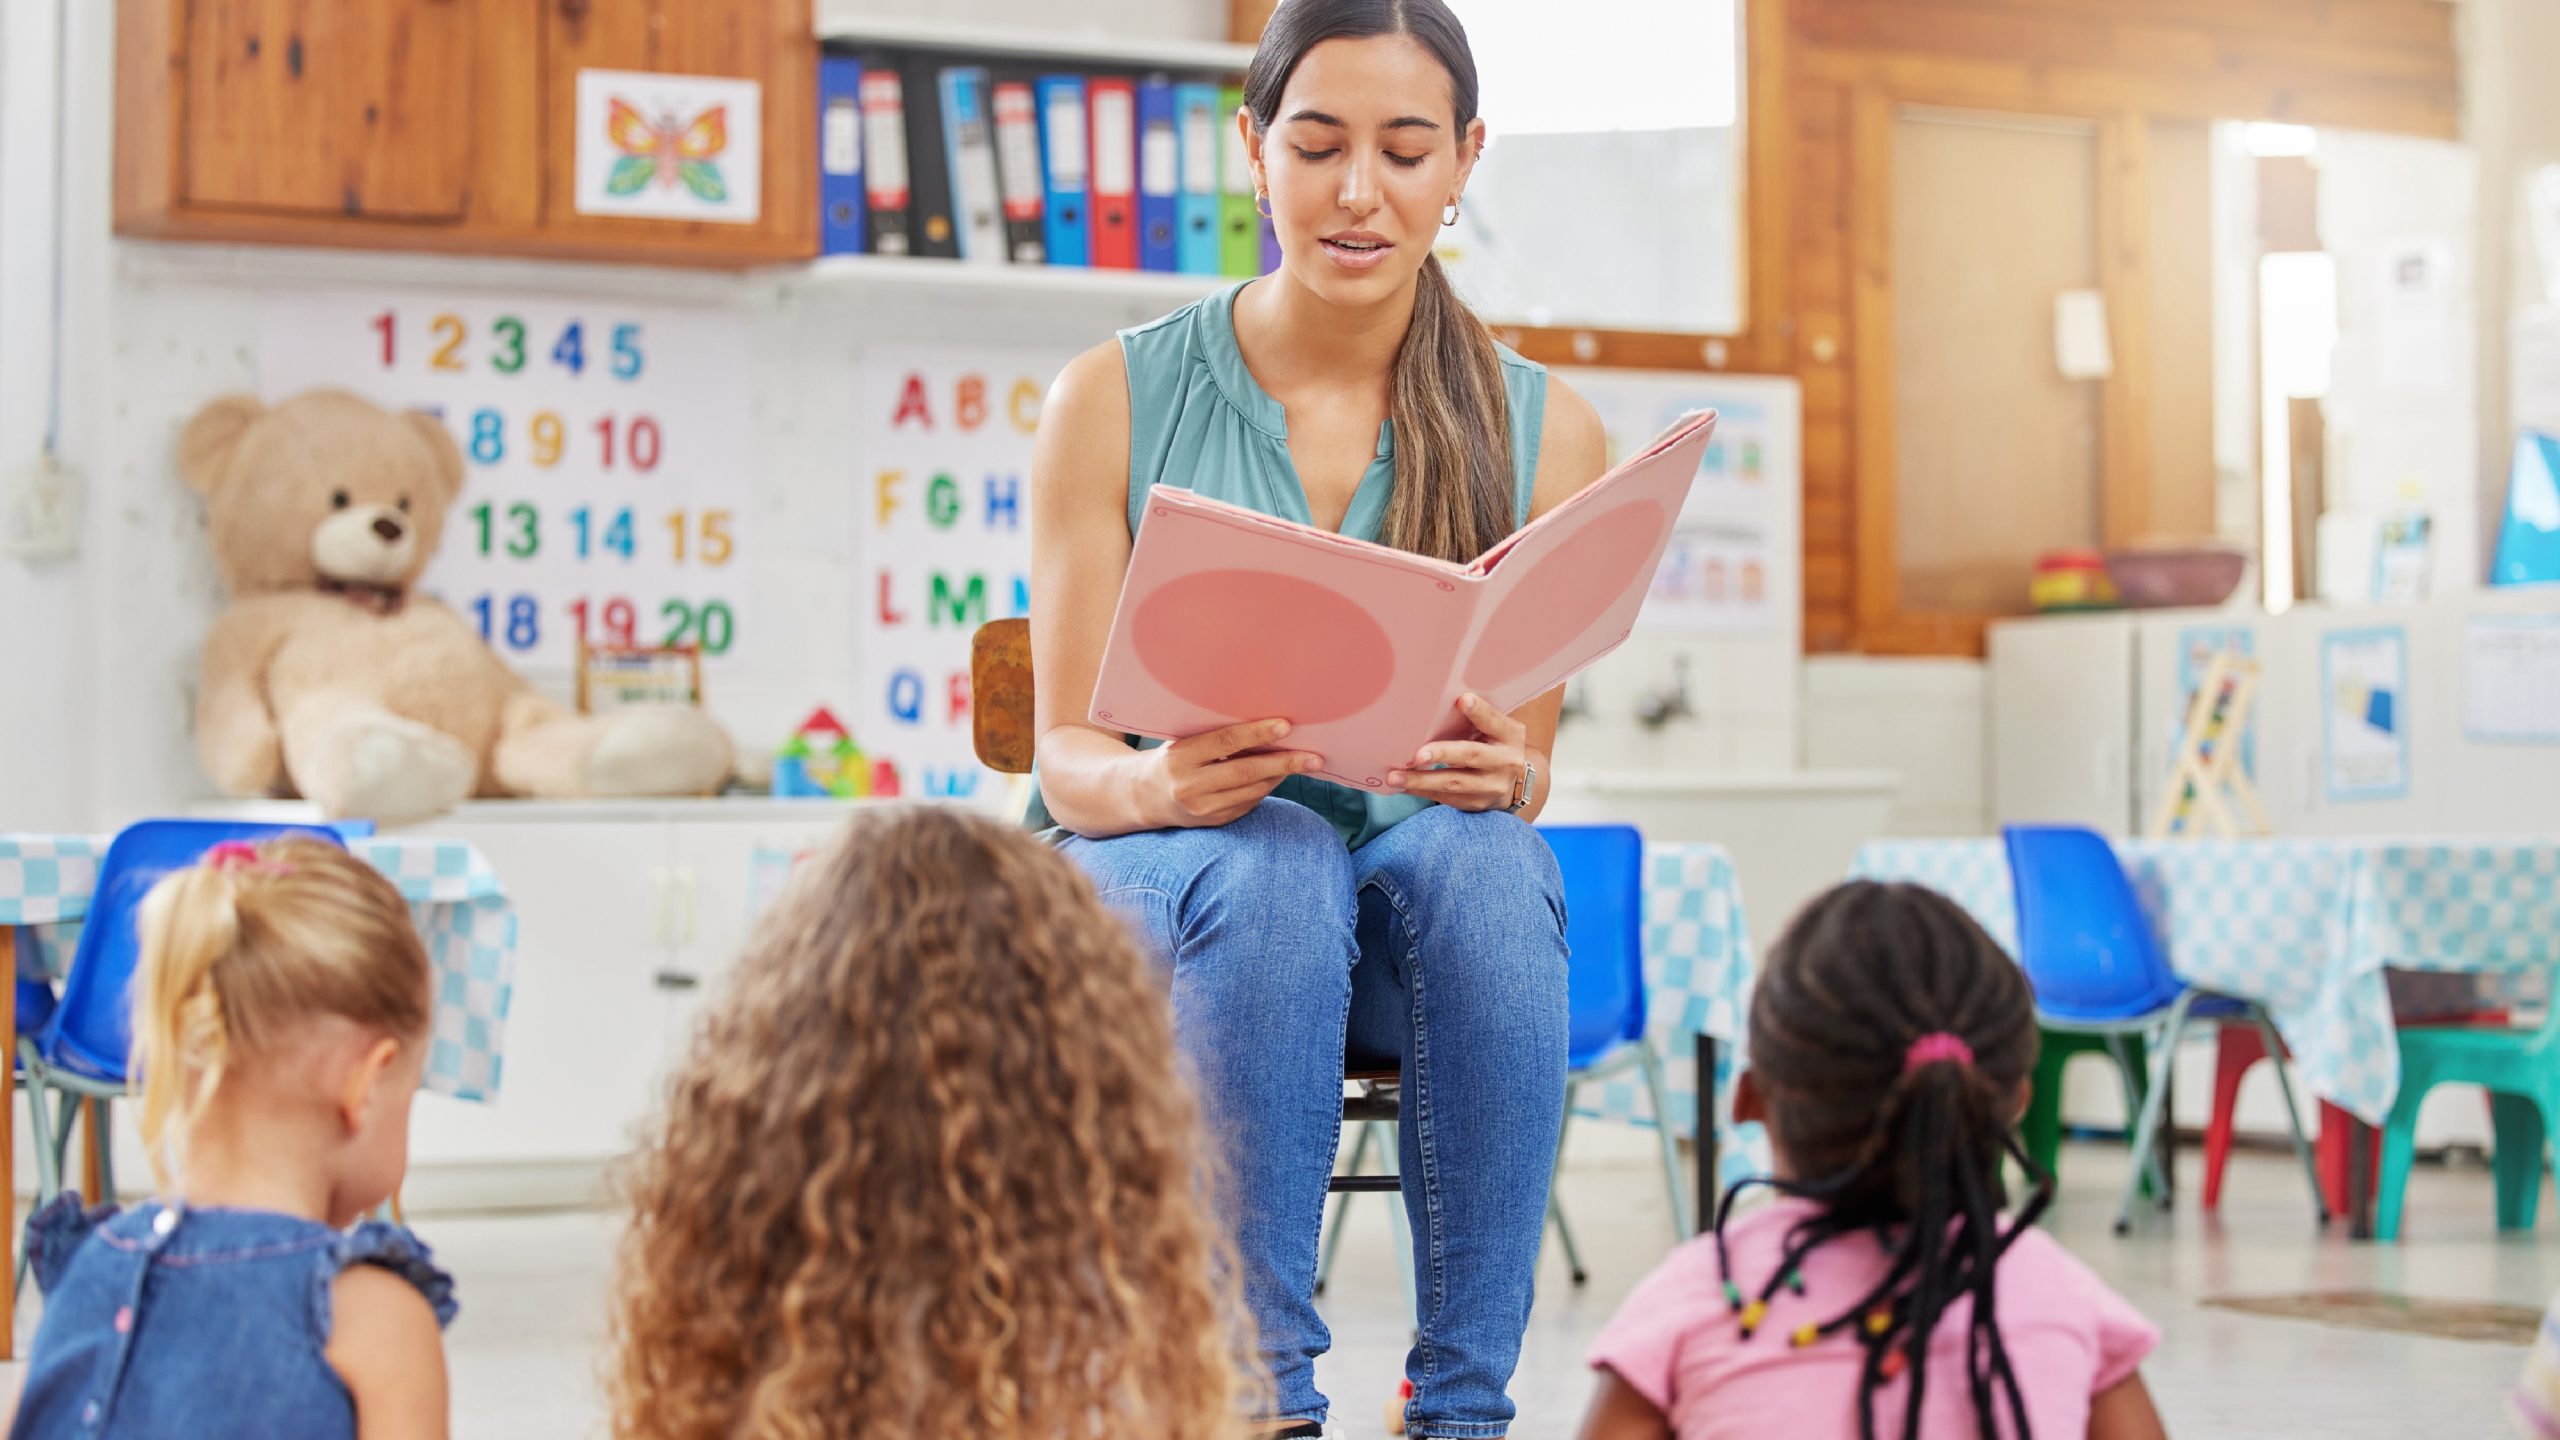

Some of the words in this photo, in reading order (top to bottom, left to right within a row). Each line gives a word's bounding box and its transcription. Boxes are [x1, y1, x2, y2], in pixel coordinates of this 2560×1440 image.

[372, 313, 396, 367] 1
[430, 314, 466, 371] 2
[492, 316, 527, 373] 3
[550, 321, 586, 375] 4
[611, 323, 643, 380] 5
[892, 374, 934, 431] A
[956, 375, 987, 431] B
[1008, 377, 1041, 434] C
[469, 408, 506, 466] 8
[529, 410, 566, 469] 9
[592, 415, 662, 473] 10
[875, 470, 904, 528] F
[926, 473, 961, 529] G
[984, 475, 1018, 528] H
[470, 501, 540, 559] 13
[568, 506, 637, 561] 14
[665, 510, 734, 567] 15
[471, 595, 540, 650] 18
[569, 597, 636, 650] 19
[659, 598, 735, 656] 20
[877, 571, 905, 626] L
[929, 573, 987, 626] M
[887, 670, 923, 725] Q
